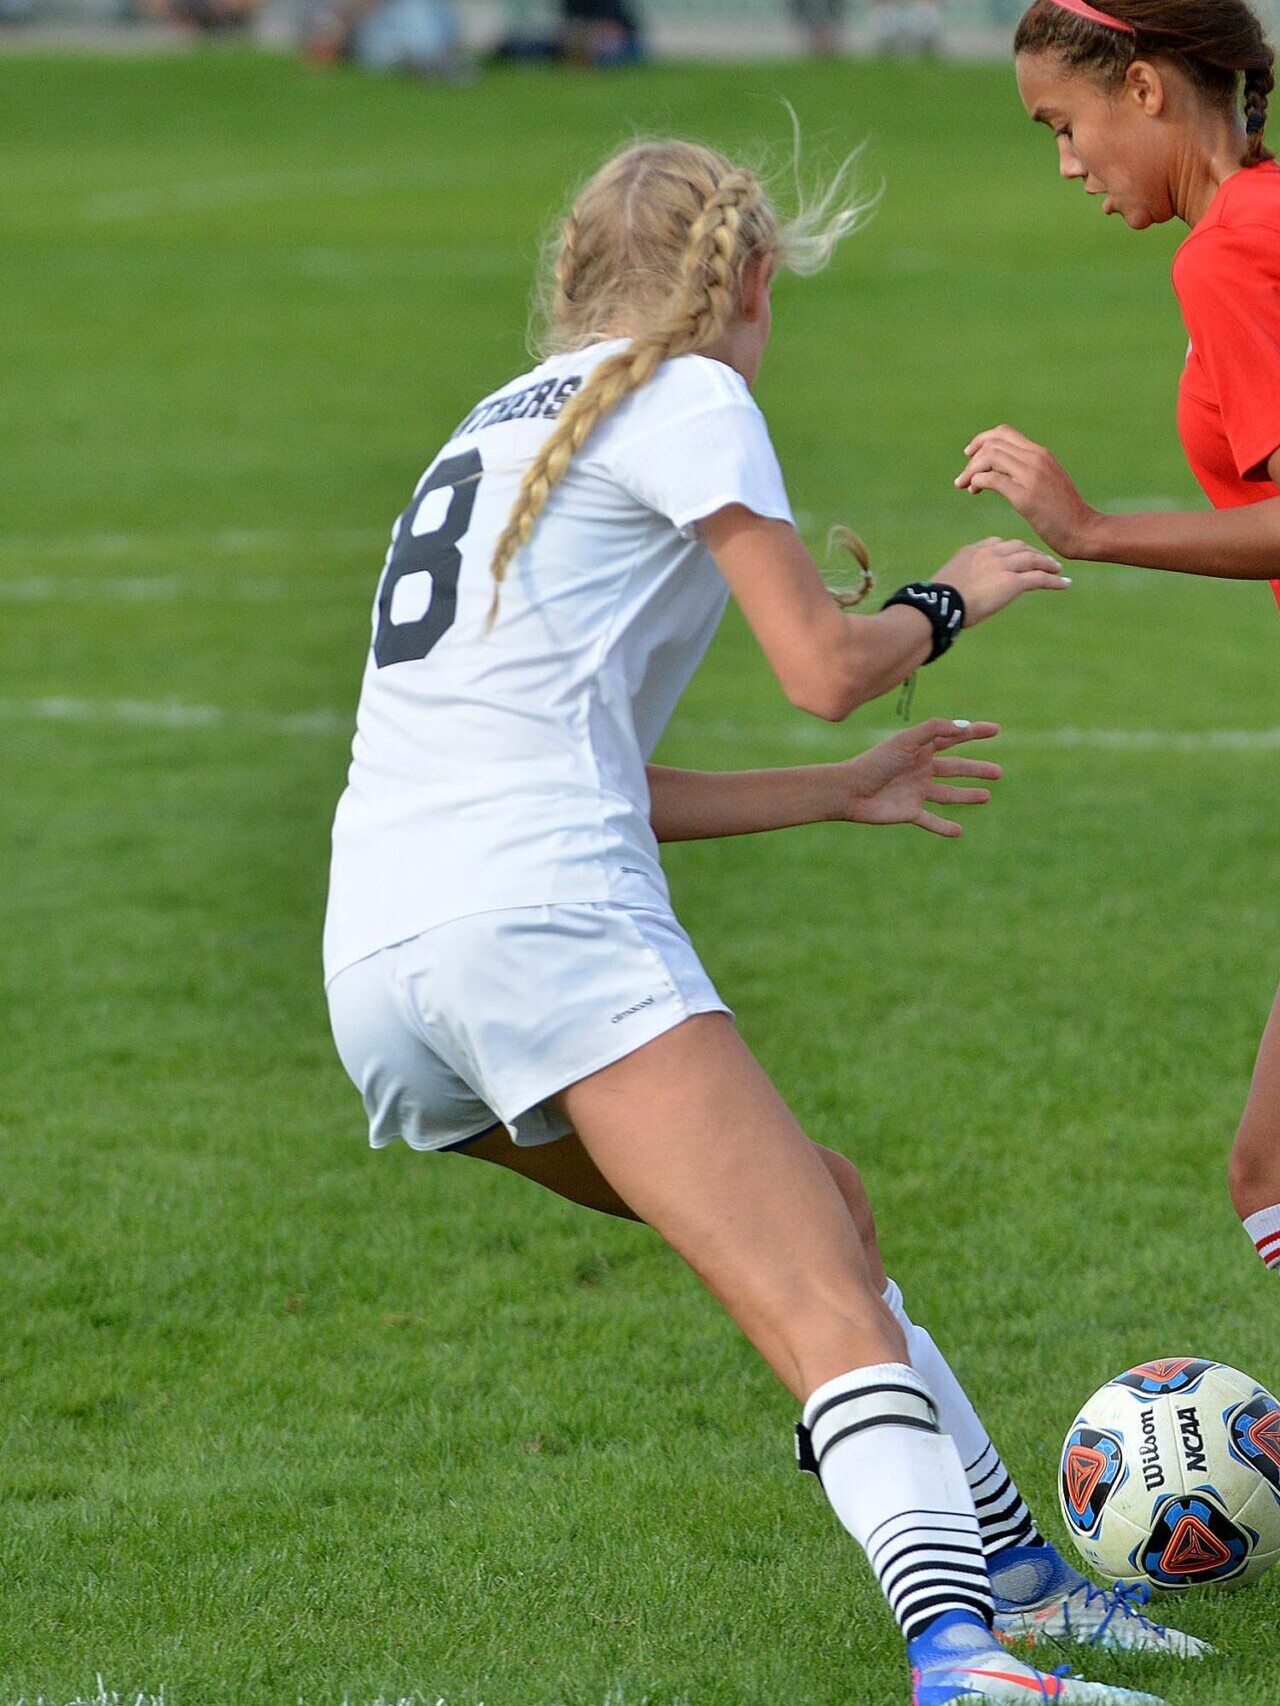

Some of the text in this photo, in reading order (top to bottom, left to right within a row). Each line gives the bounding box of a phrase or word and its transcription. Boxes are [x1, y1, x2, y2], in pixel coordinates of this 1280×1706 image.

[374, 447, 484, 669] 8
[1140, 1406, 1165, 1491] Wilson
[1177, 1406, 1208, 1473] NCAA
